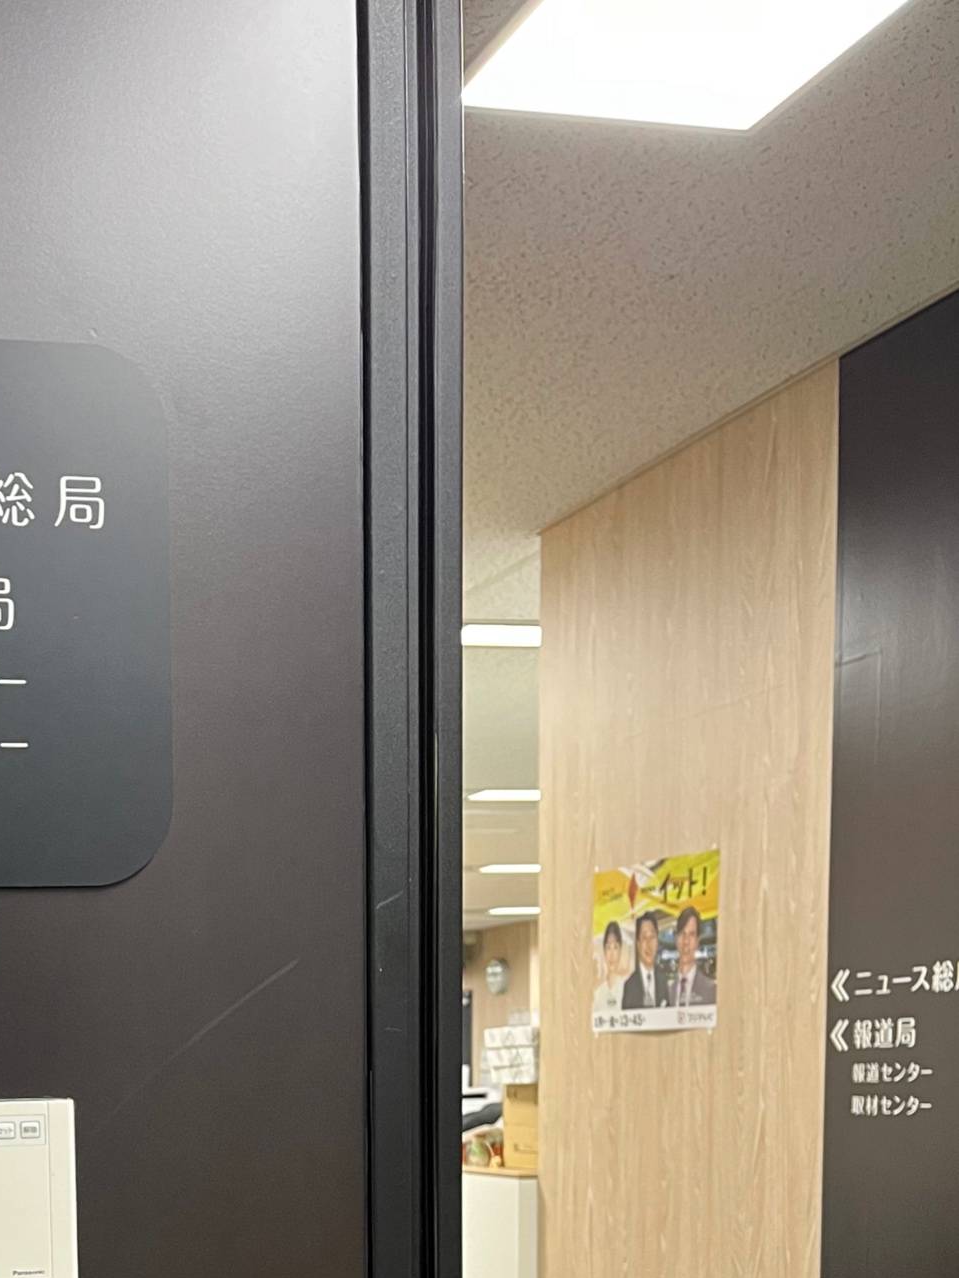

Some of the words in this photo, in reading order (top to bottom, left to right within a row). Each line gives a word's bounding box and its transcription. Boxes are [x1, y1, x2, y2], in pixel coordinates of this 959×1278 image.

[854, 960, 959, 995] ニュース総
[853, 1017, 916, 1049] 報道局
[852, 1062, 933, 1083] 報道センター
[851, 1094, 932, 1116] 取材センター
